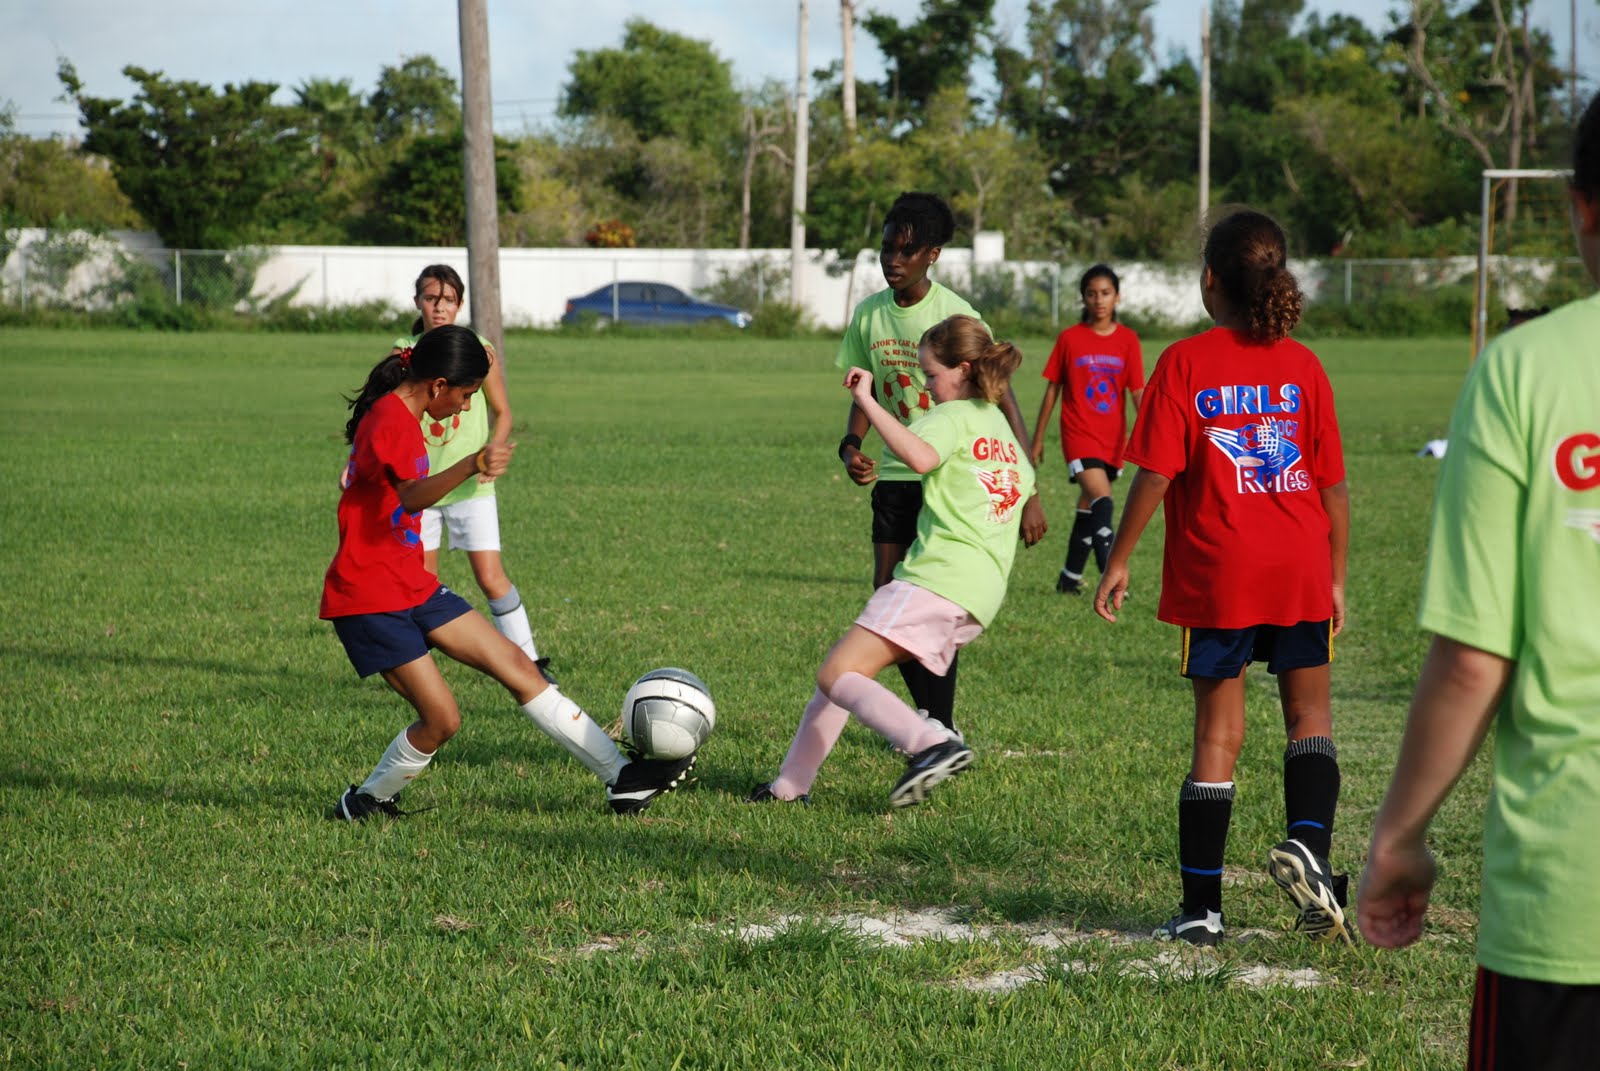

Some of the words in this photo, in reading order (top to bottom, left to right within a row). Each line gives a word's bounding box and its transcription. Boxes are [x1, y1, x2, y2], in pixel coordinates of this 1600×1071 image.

[1195, 384, 1301, 419] GIRLS
[972, 437, 1018, 464] GIRLS
[1236, 466, 1312, 494] Rules
